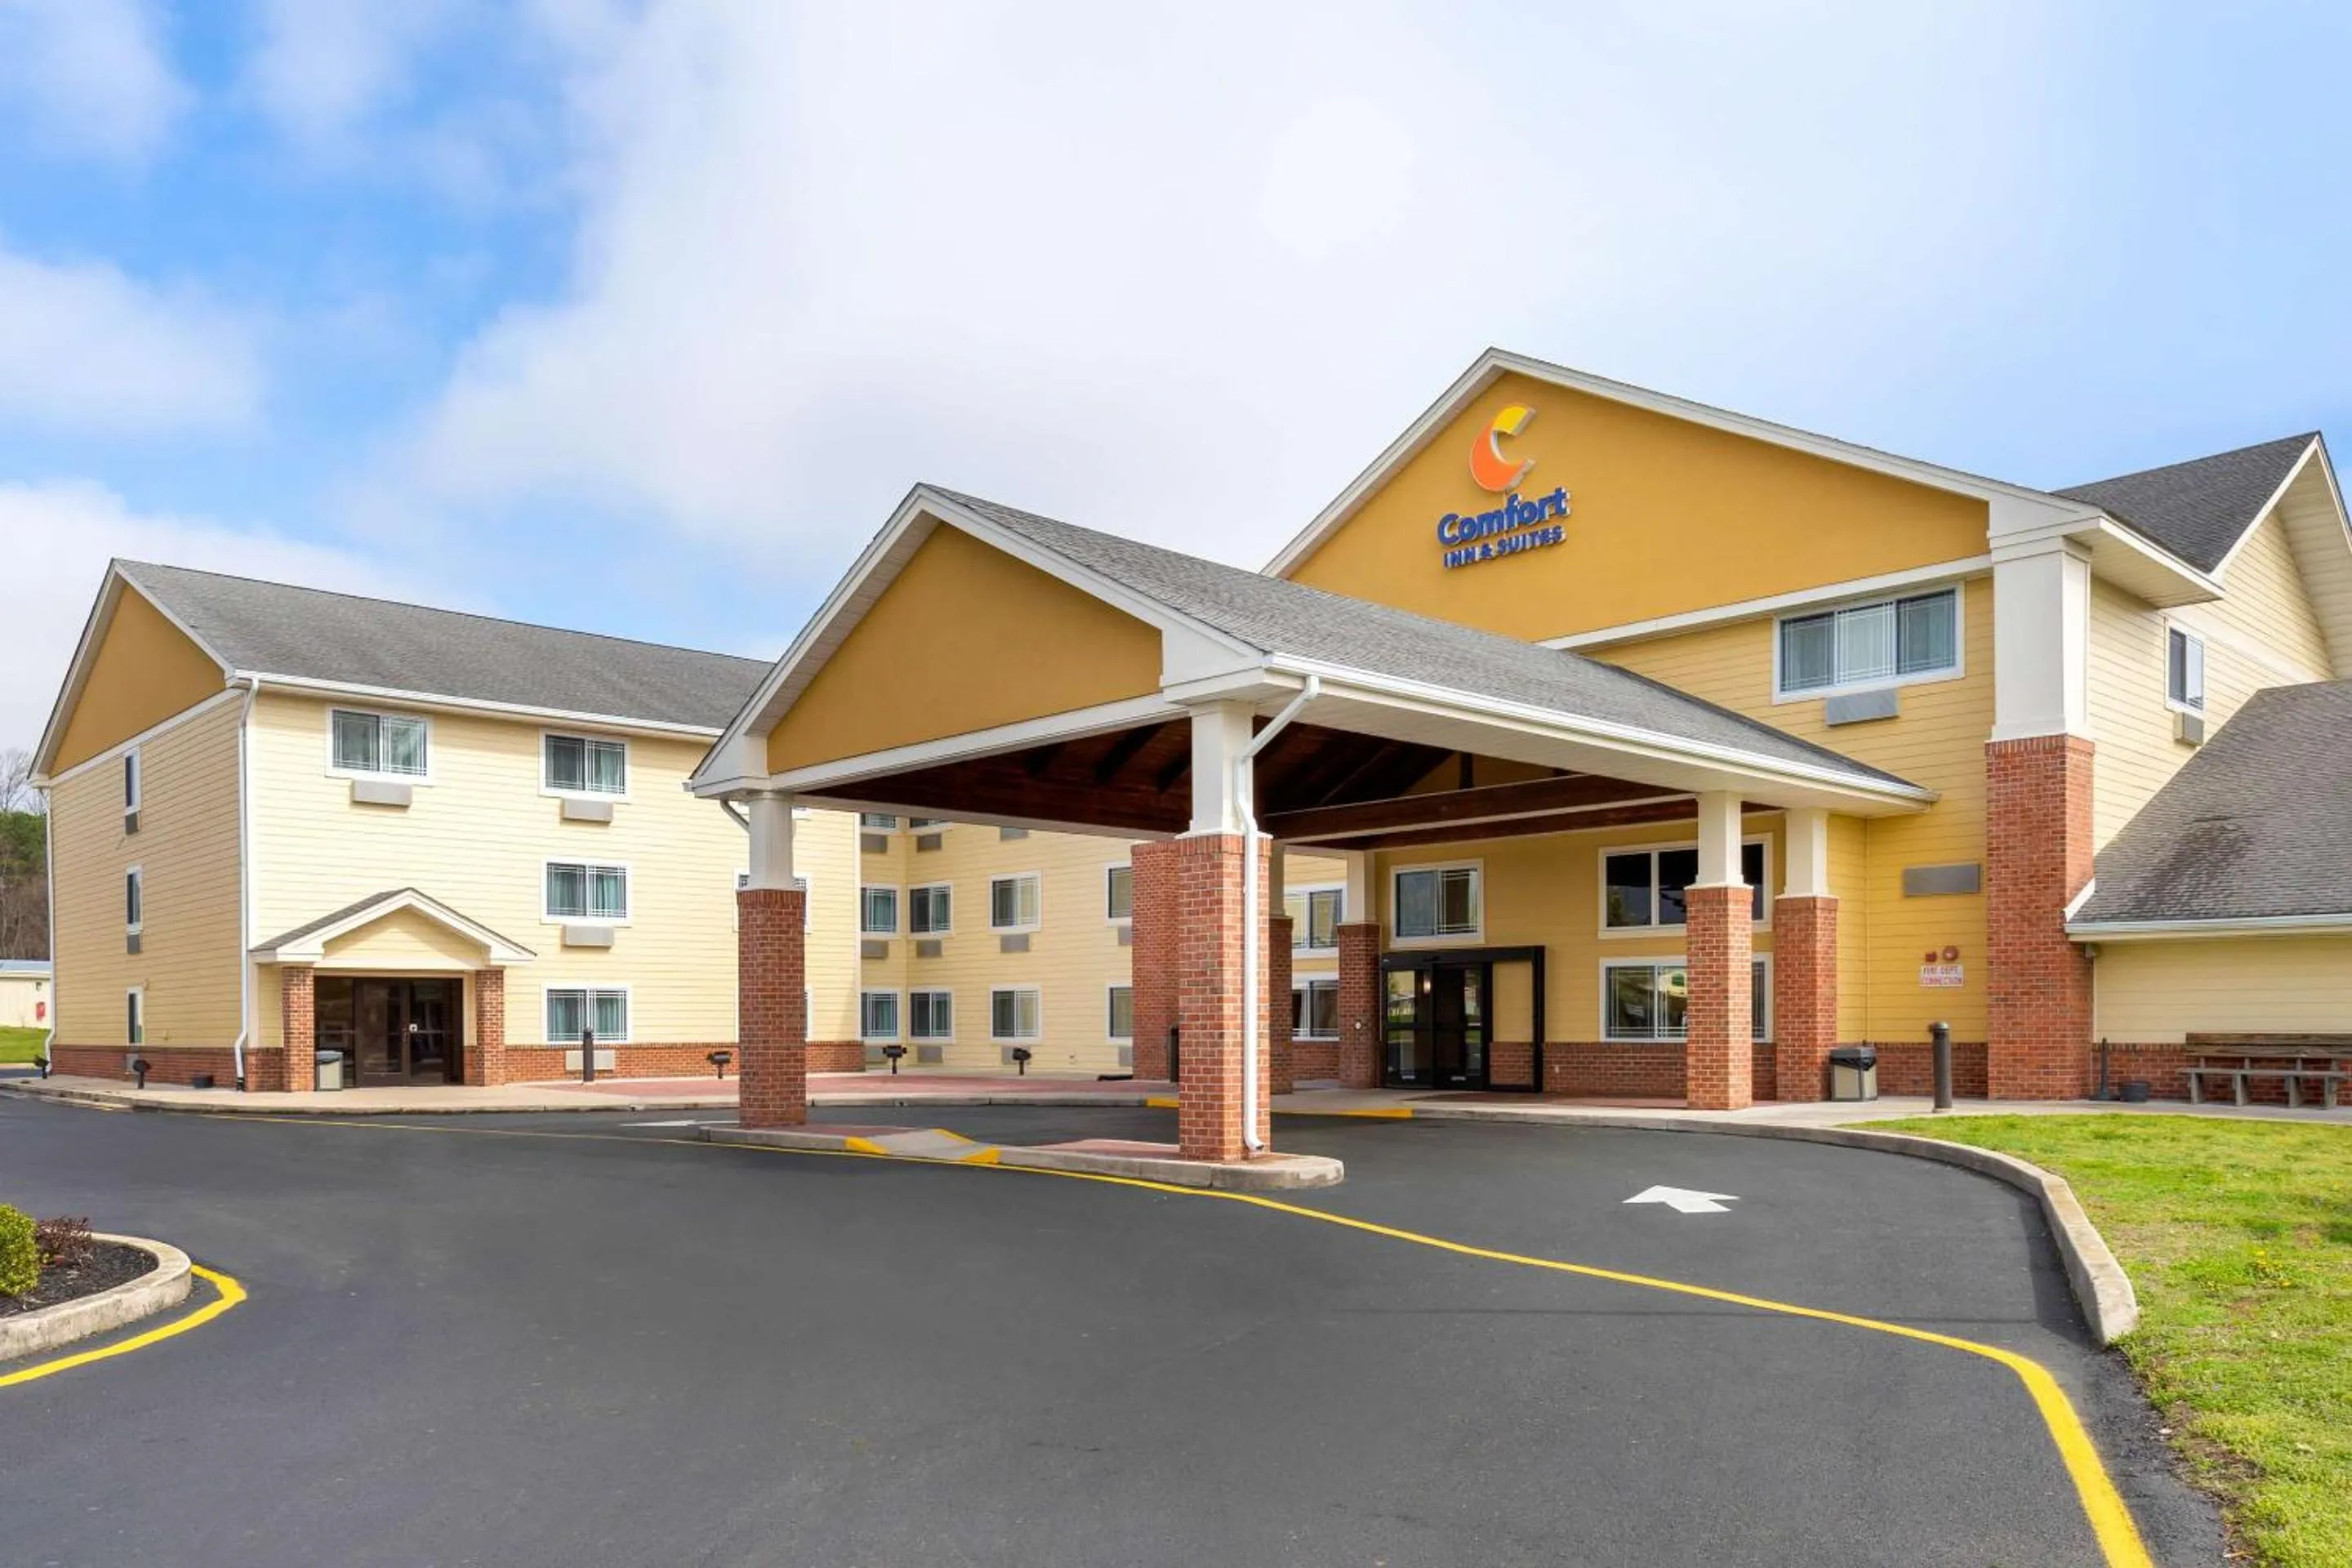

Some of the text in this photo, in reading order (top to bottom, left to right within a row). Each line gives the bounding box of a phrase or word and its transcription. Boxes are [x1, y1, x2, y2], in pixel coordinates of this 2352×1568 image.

[1437, 487, 1570, 545] Comfort
[1444, 525, 1566, 568] INN & SUITES
